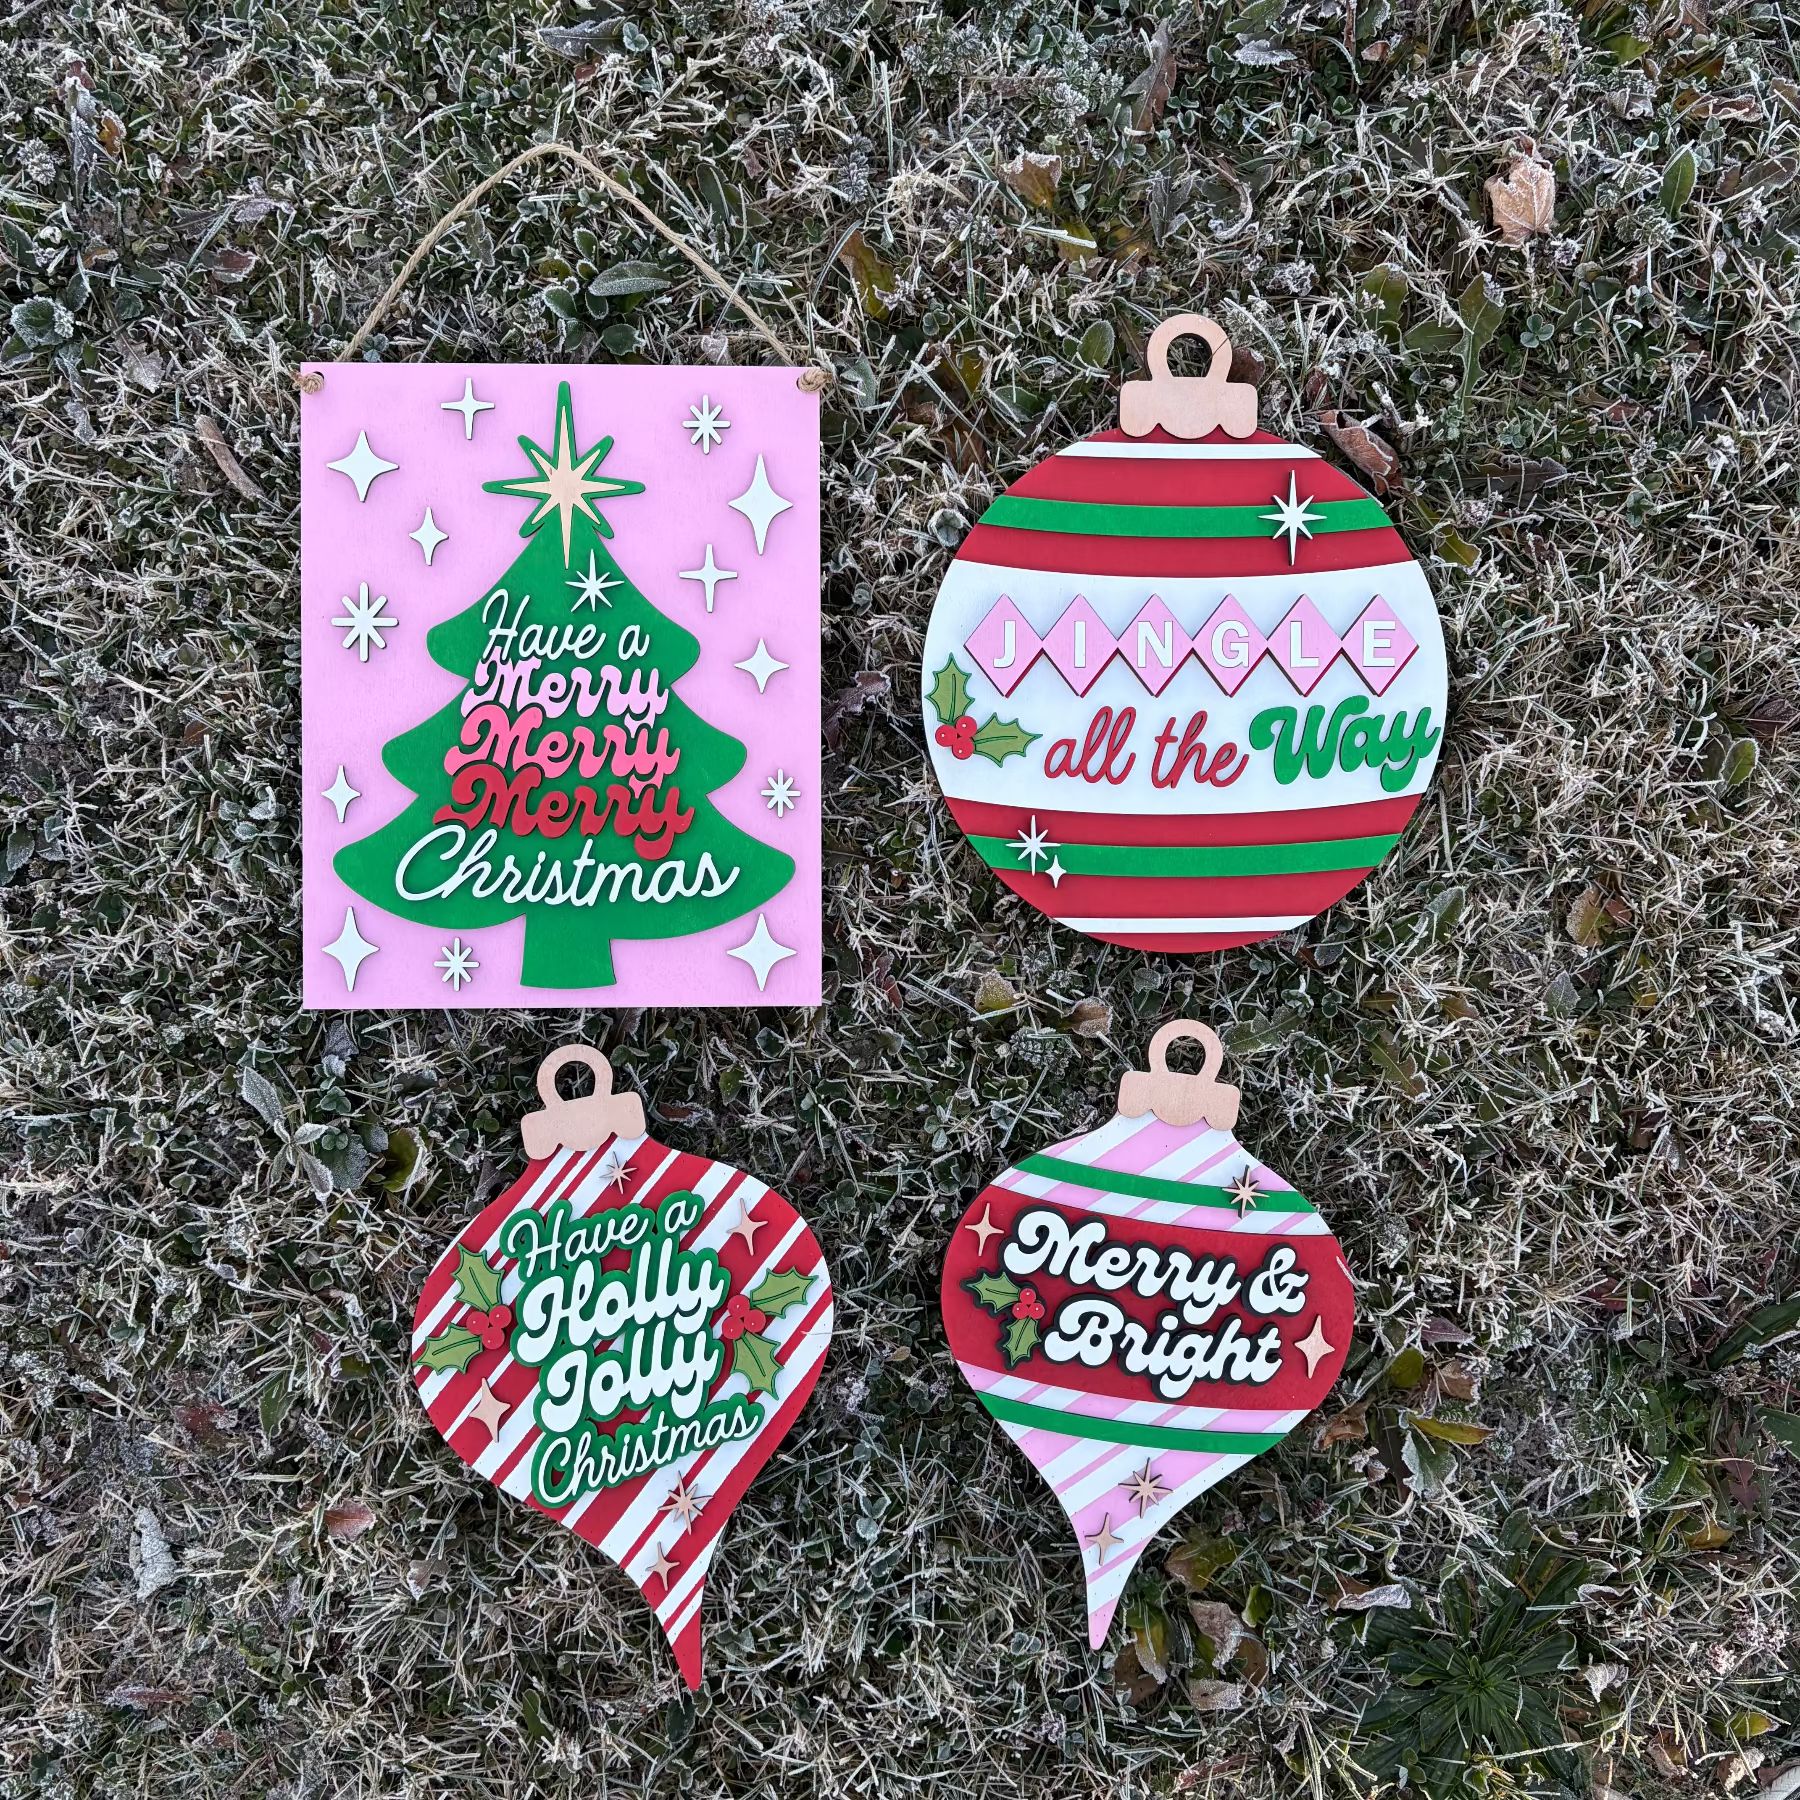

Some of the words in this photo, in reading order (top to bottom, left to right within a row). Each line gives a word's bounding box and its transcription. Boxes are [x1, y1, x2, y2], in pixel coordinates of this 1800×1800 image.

[482, 589, 606, 660] Have
[618, 625, 650, 660] a
[993, 620, 1396, 668] JINGLE
[461, 646, 668, 738] Merry
[444, 705, 680, 798] Merry
[1044, 706, 1136, 784] all
[1151, 711, 1249, 789] the
[1249, 695, 1440, 792] Way
[433, 764, 694, 860] Merry
[395, 825, 740, 906] Christmas
[508, 1208, 648, 1277] Have
[665, 1200, 698, 1232] a
[1004, 1210, 1241, 1325] Merry
[1249, 1247, 1308, 1314] &
[517, 1237, 724, 1363] Holly
[541, 1320, 719, 1432] Jolly
[1044, 1299, 1282, 1398] Bright
[539, 1406, 758, 1503] Christmas
